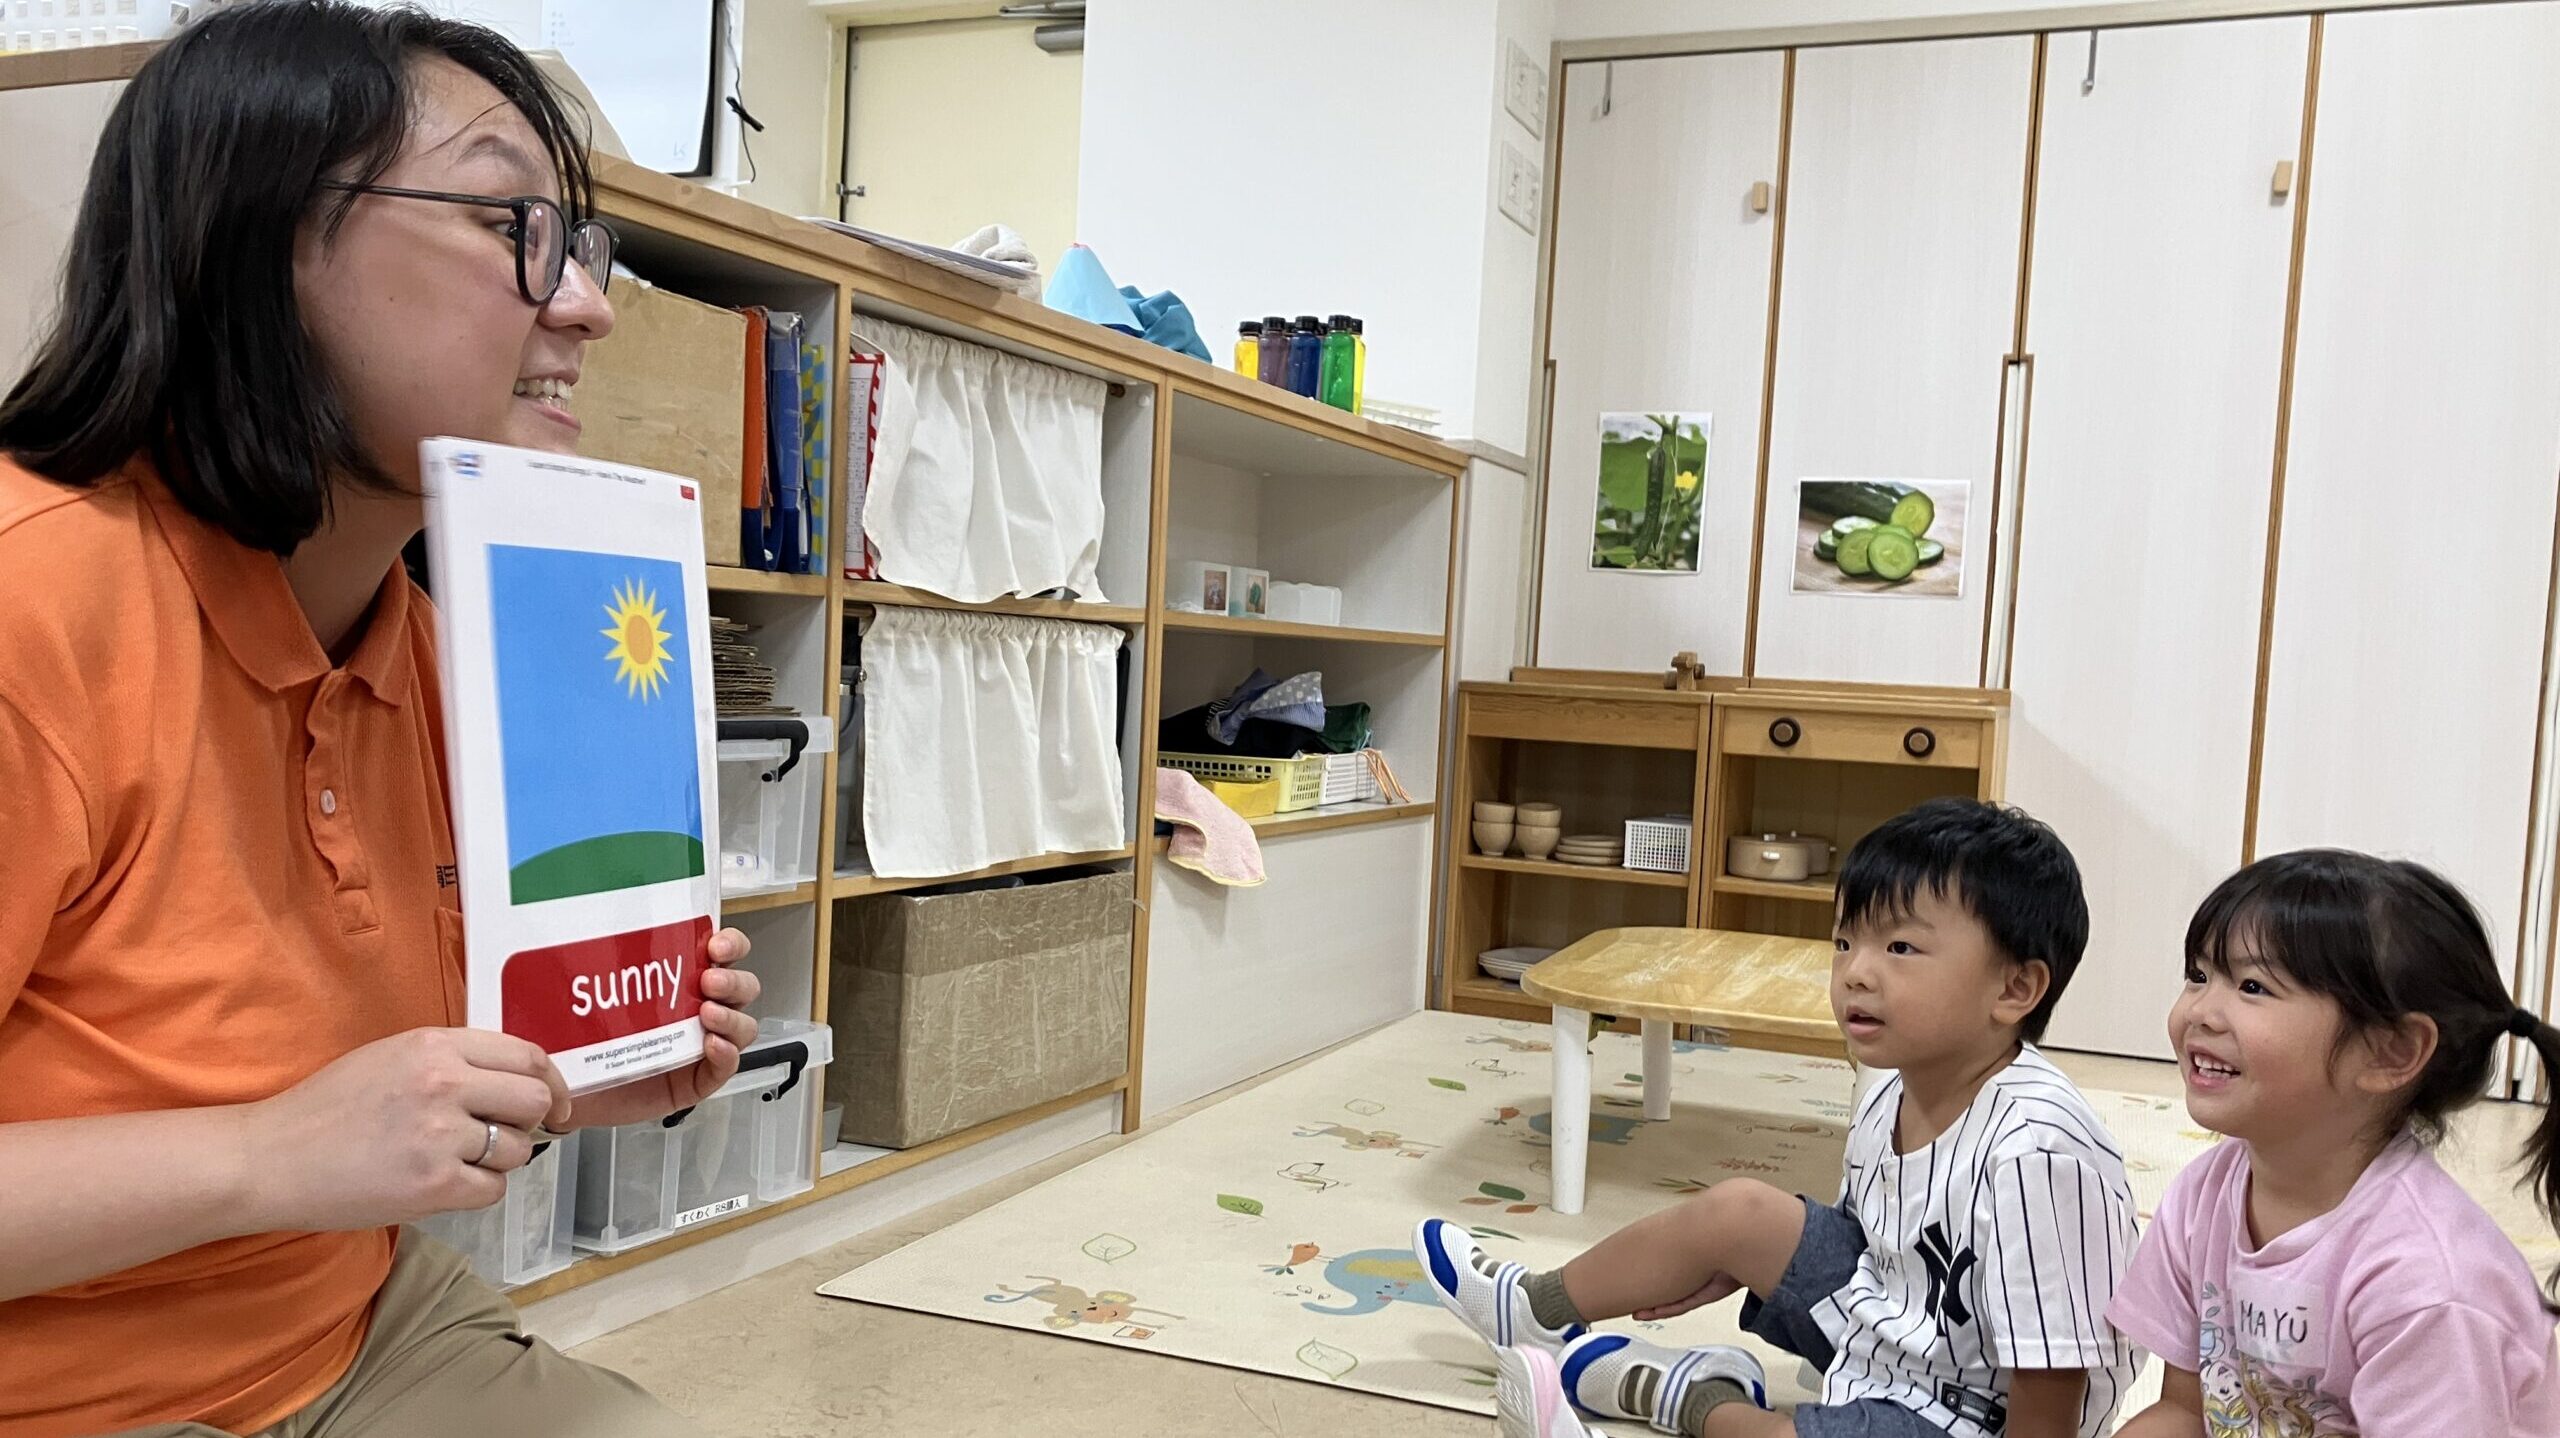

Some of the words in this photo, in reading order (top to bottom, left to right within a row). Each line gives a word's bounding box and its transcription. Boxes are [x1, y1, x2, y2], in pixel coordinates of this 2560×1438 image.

[571, 954, 682, 1017] sunny
[583, 1030, 685, 1064] www.supersimplelearning.com
[1913, 1220, 1978, 1337] NY
